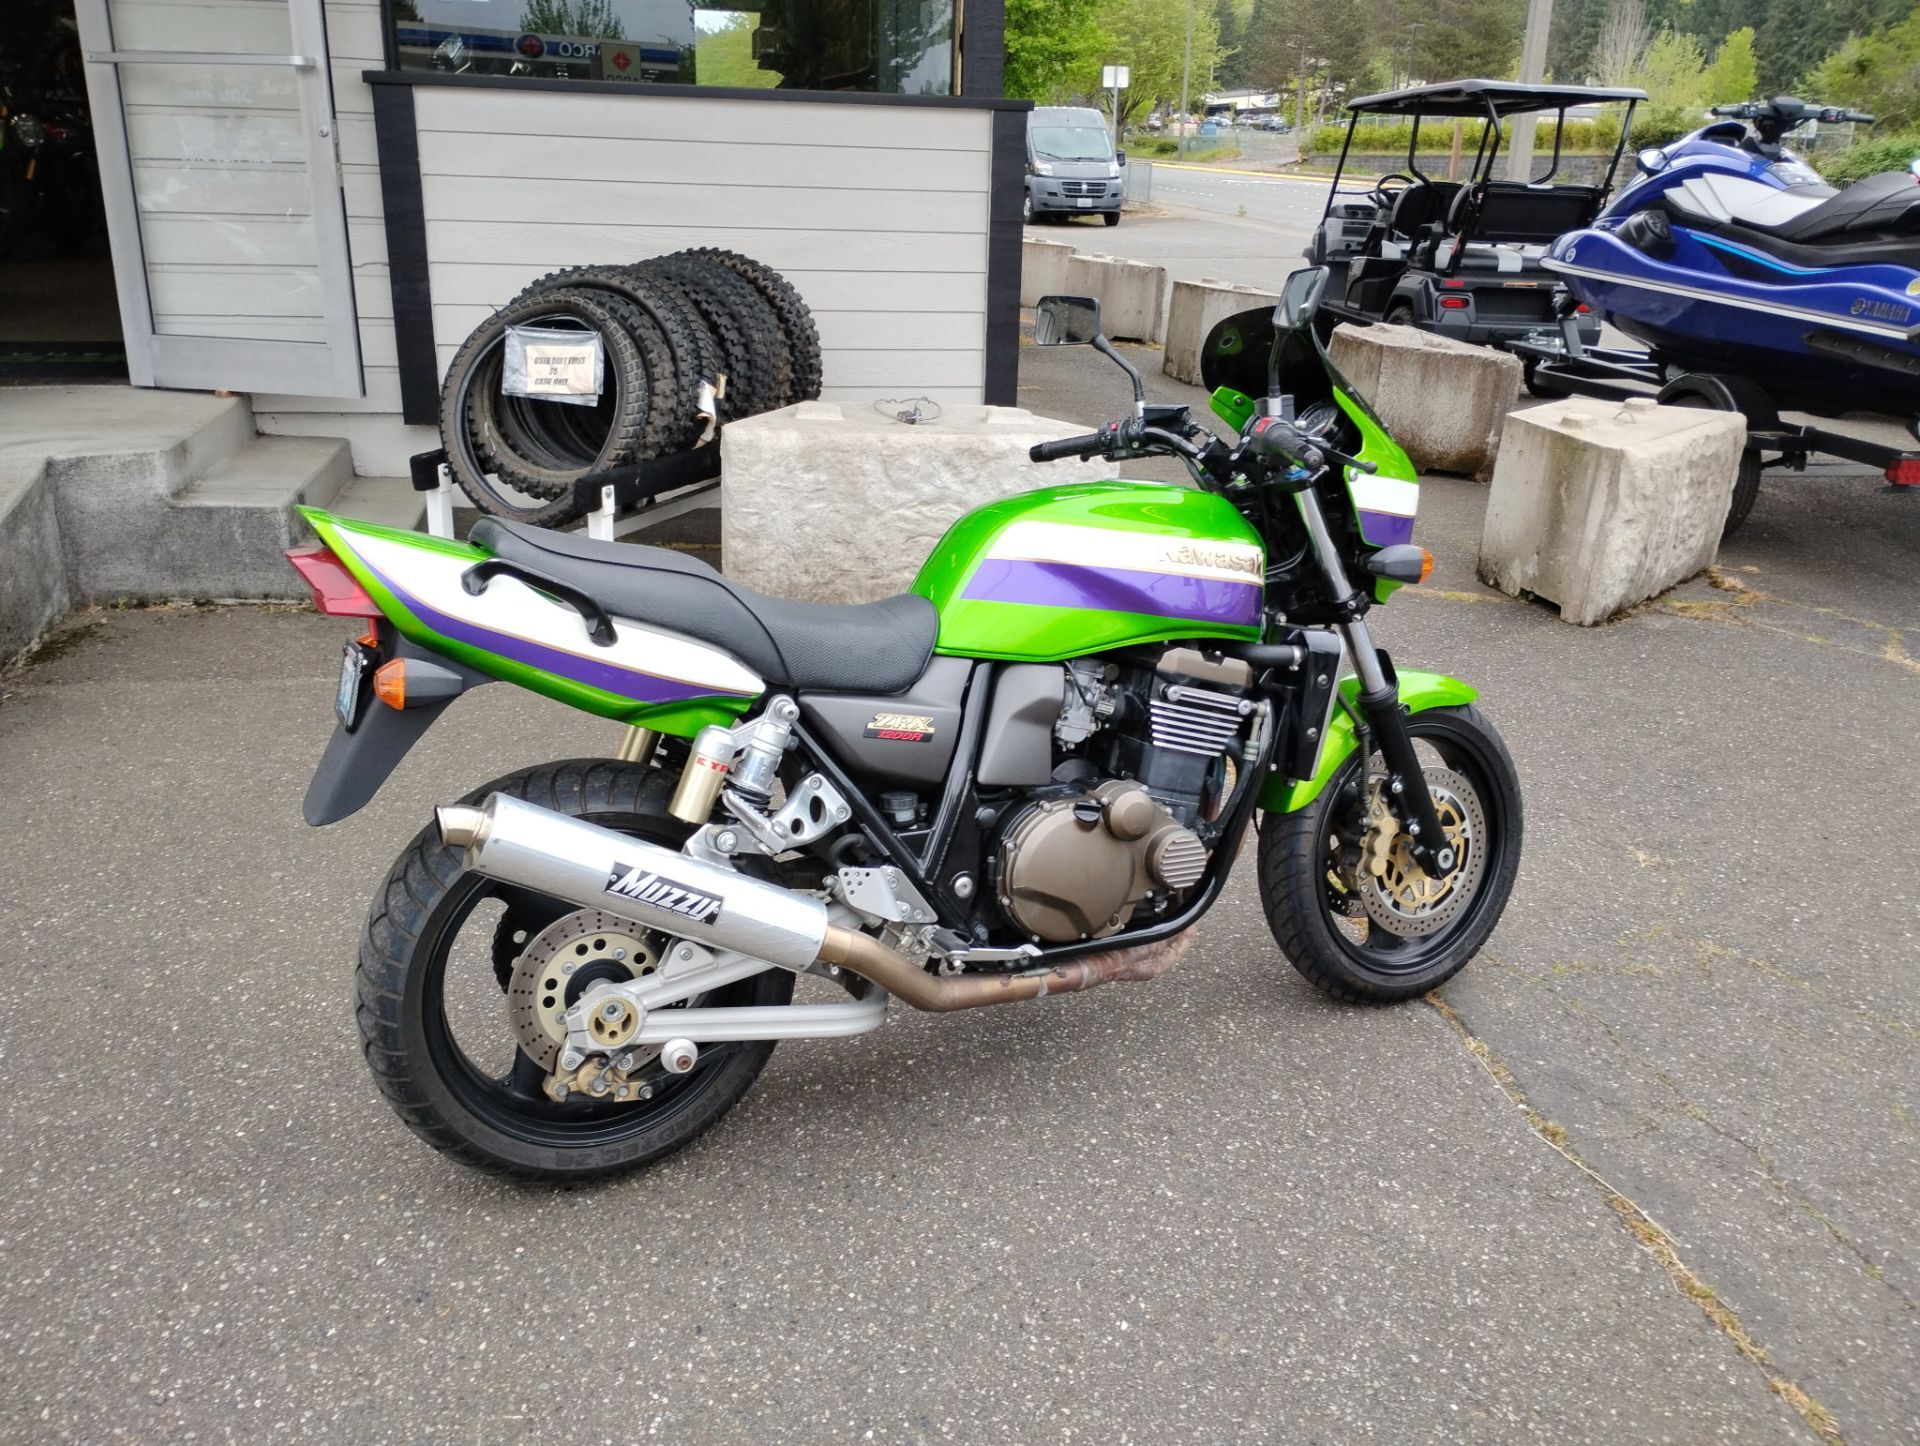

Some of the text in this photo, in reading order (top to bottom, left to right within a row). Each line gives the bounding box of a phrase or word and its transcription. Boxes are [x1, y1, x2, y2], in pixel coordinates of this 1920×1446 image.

[1864, 300, 1912, 322] YAMAHA
[568, 356, 586, 365] TIRES
[552, 378, 569, 386] ONLY
[871, 713, 933, 732] ZRX
[879, 730, 923, 740] 1200R
